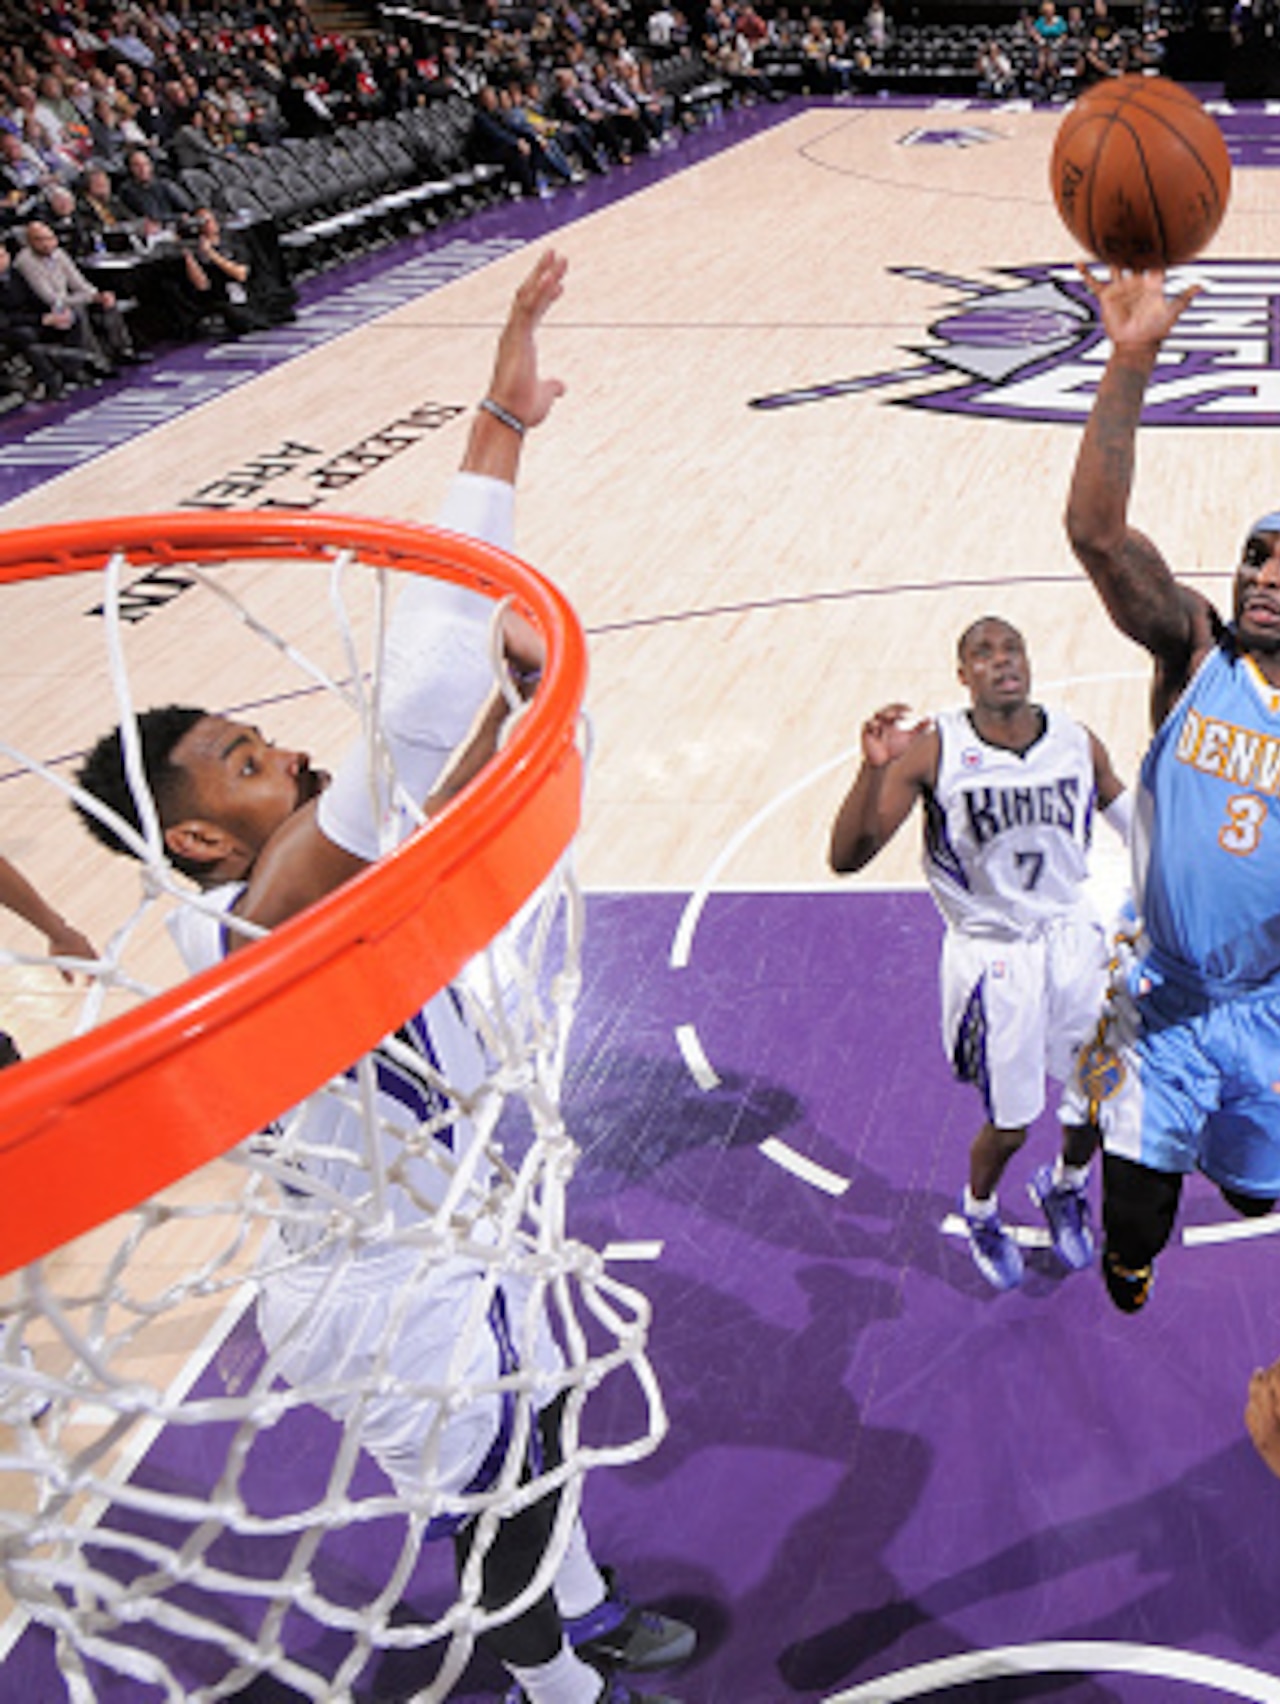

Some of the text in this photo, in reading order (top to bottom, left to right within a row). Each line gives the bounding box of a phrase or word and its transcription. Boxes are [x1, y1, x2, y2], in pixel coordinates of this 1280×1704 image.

[963, 775, 1080, 847] KINGS
[1218, 793, 1268, 857] 3
[1014, 851, 1046, 891] 7
